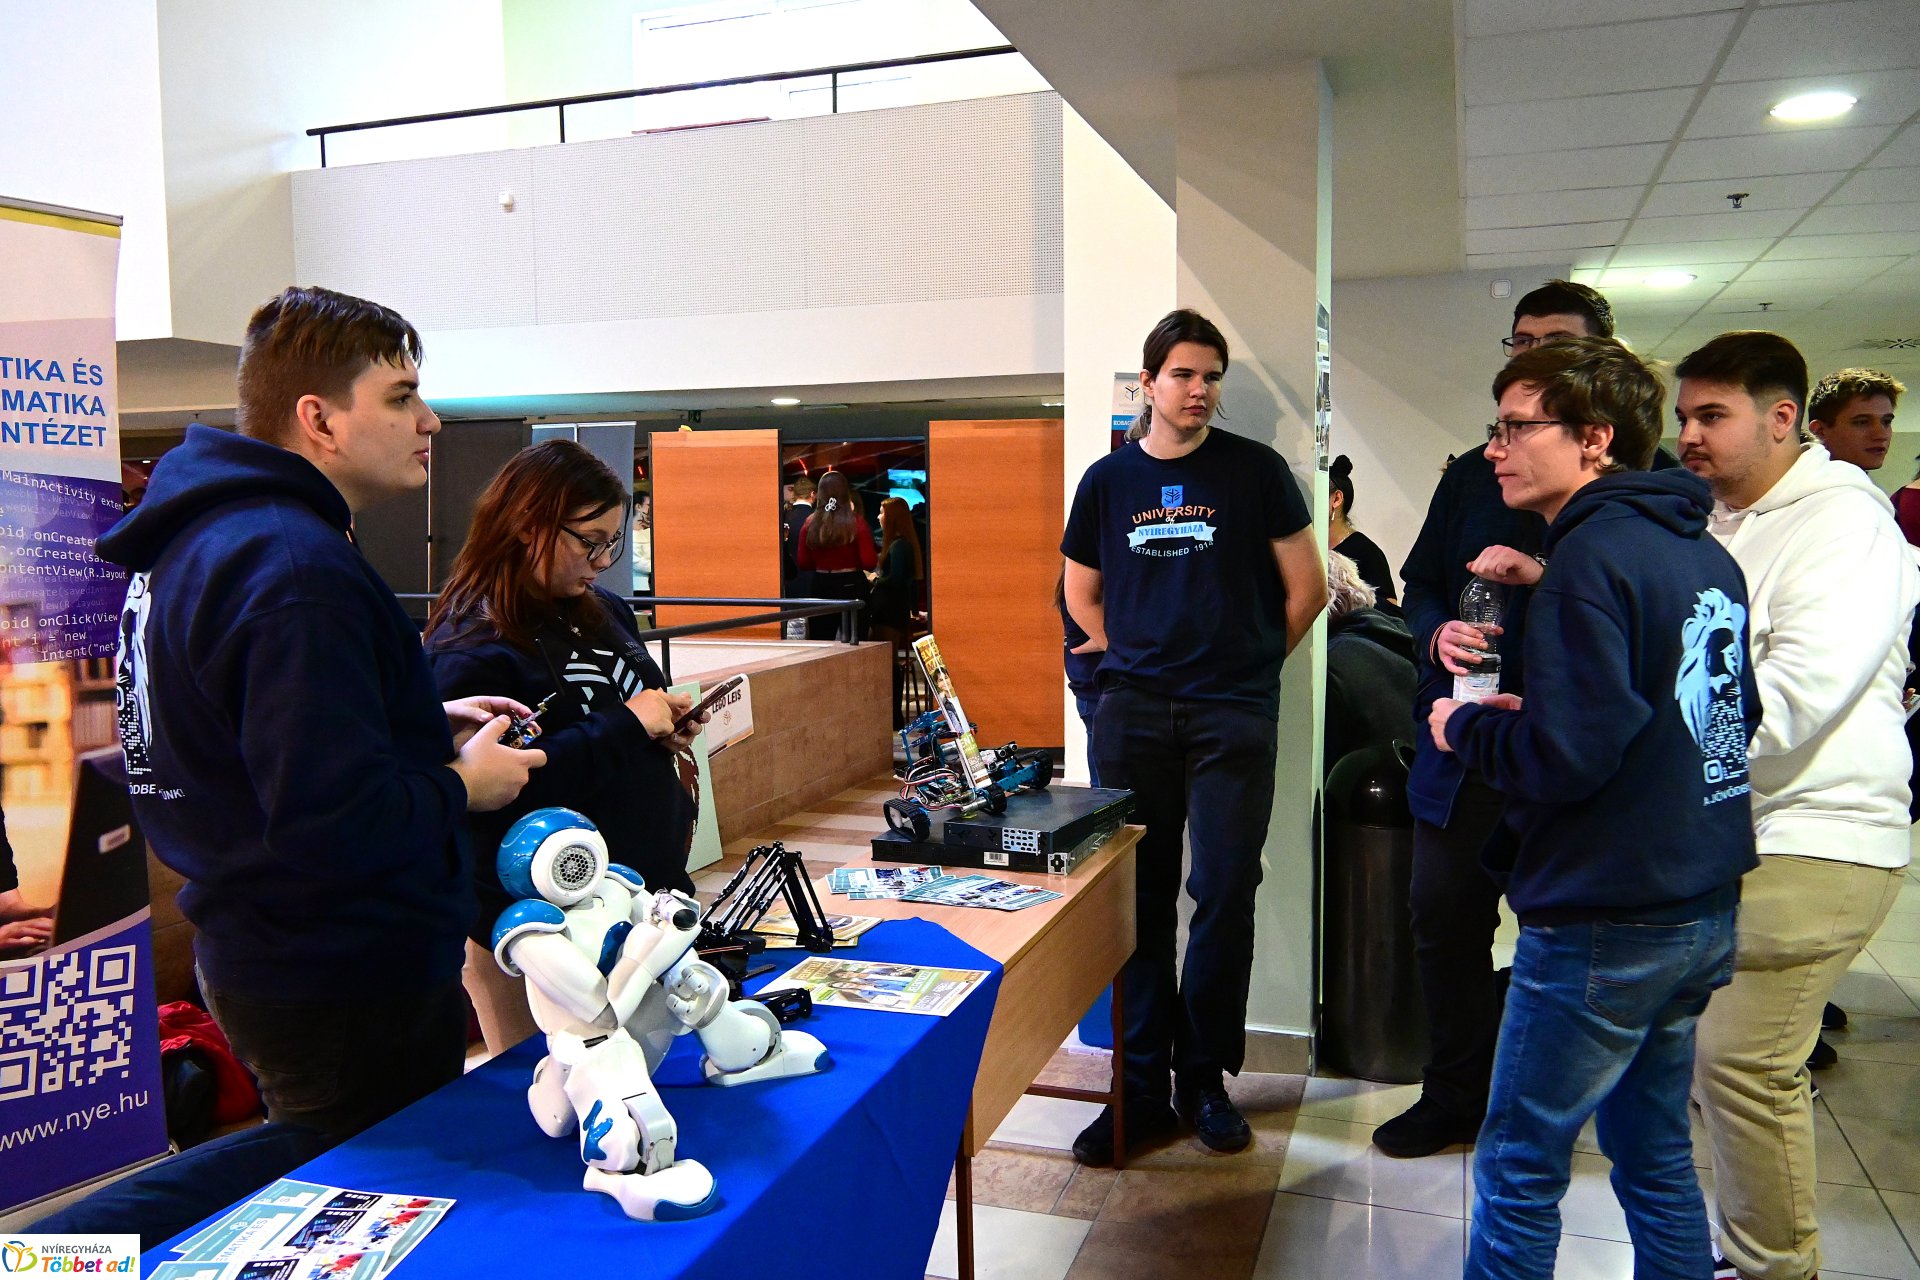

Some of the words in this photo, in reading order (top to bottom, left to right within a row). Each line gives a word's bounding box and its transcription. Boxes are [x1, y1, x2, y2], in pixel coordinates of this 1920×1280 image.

[0, 357, 65, 382] TIKA
[72, 357, 104, 386] ÉS
[2, 389, 106, 416] MATIKA
[1, 417, 107, 447] NTÉZET
[1132, 505, 1216, 524] UNIVERSITY
[1130, 545, 1190, 557] ESTABLISHED
[64, 631, 87, 642] new
[0, 1090, 148, 1150] www.nye.hu
